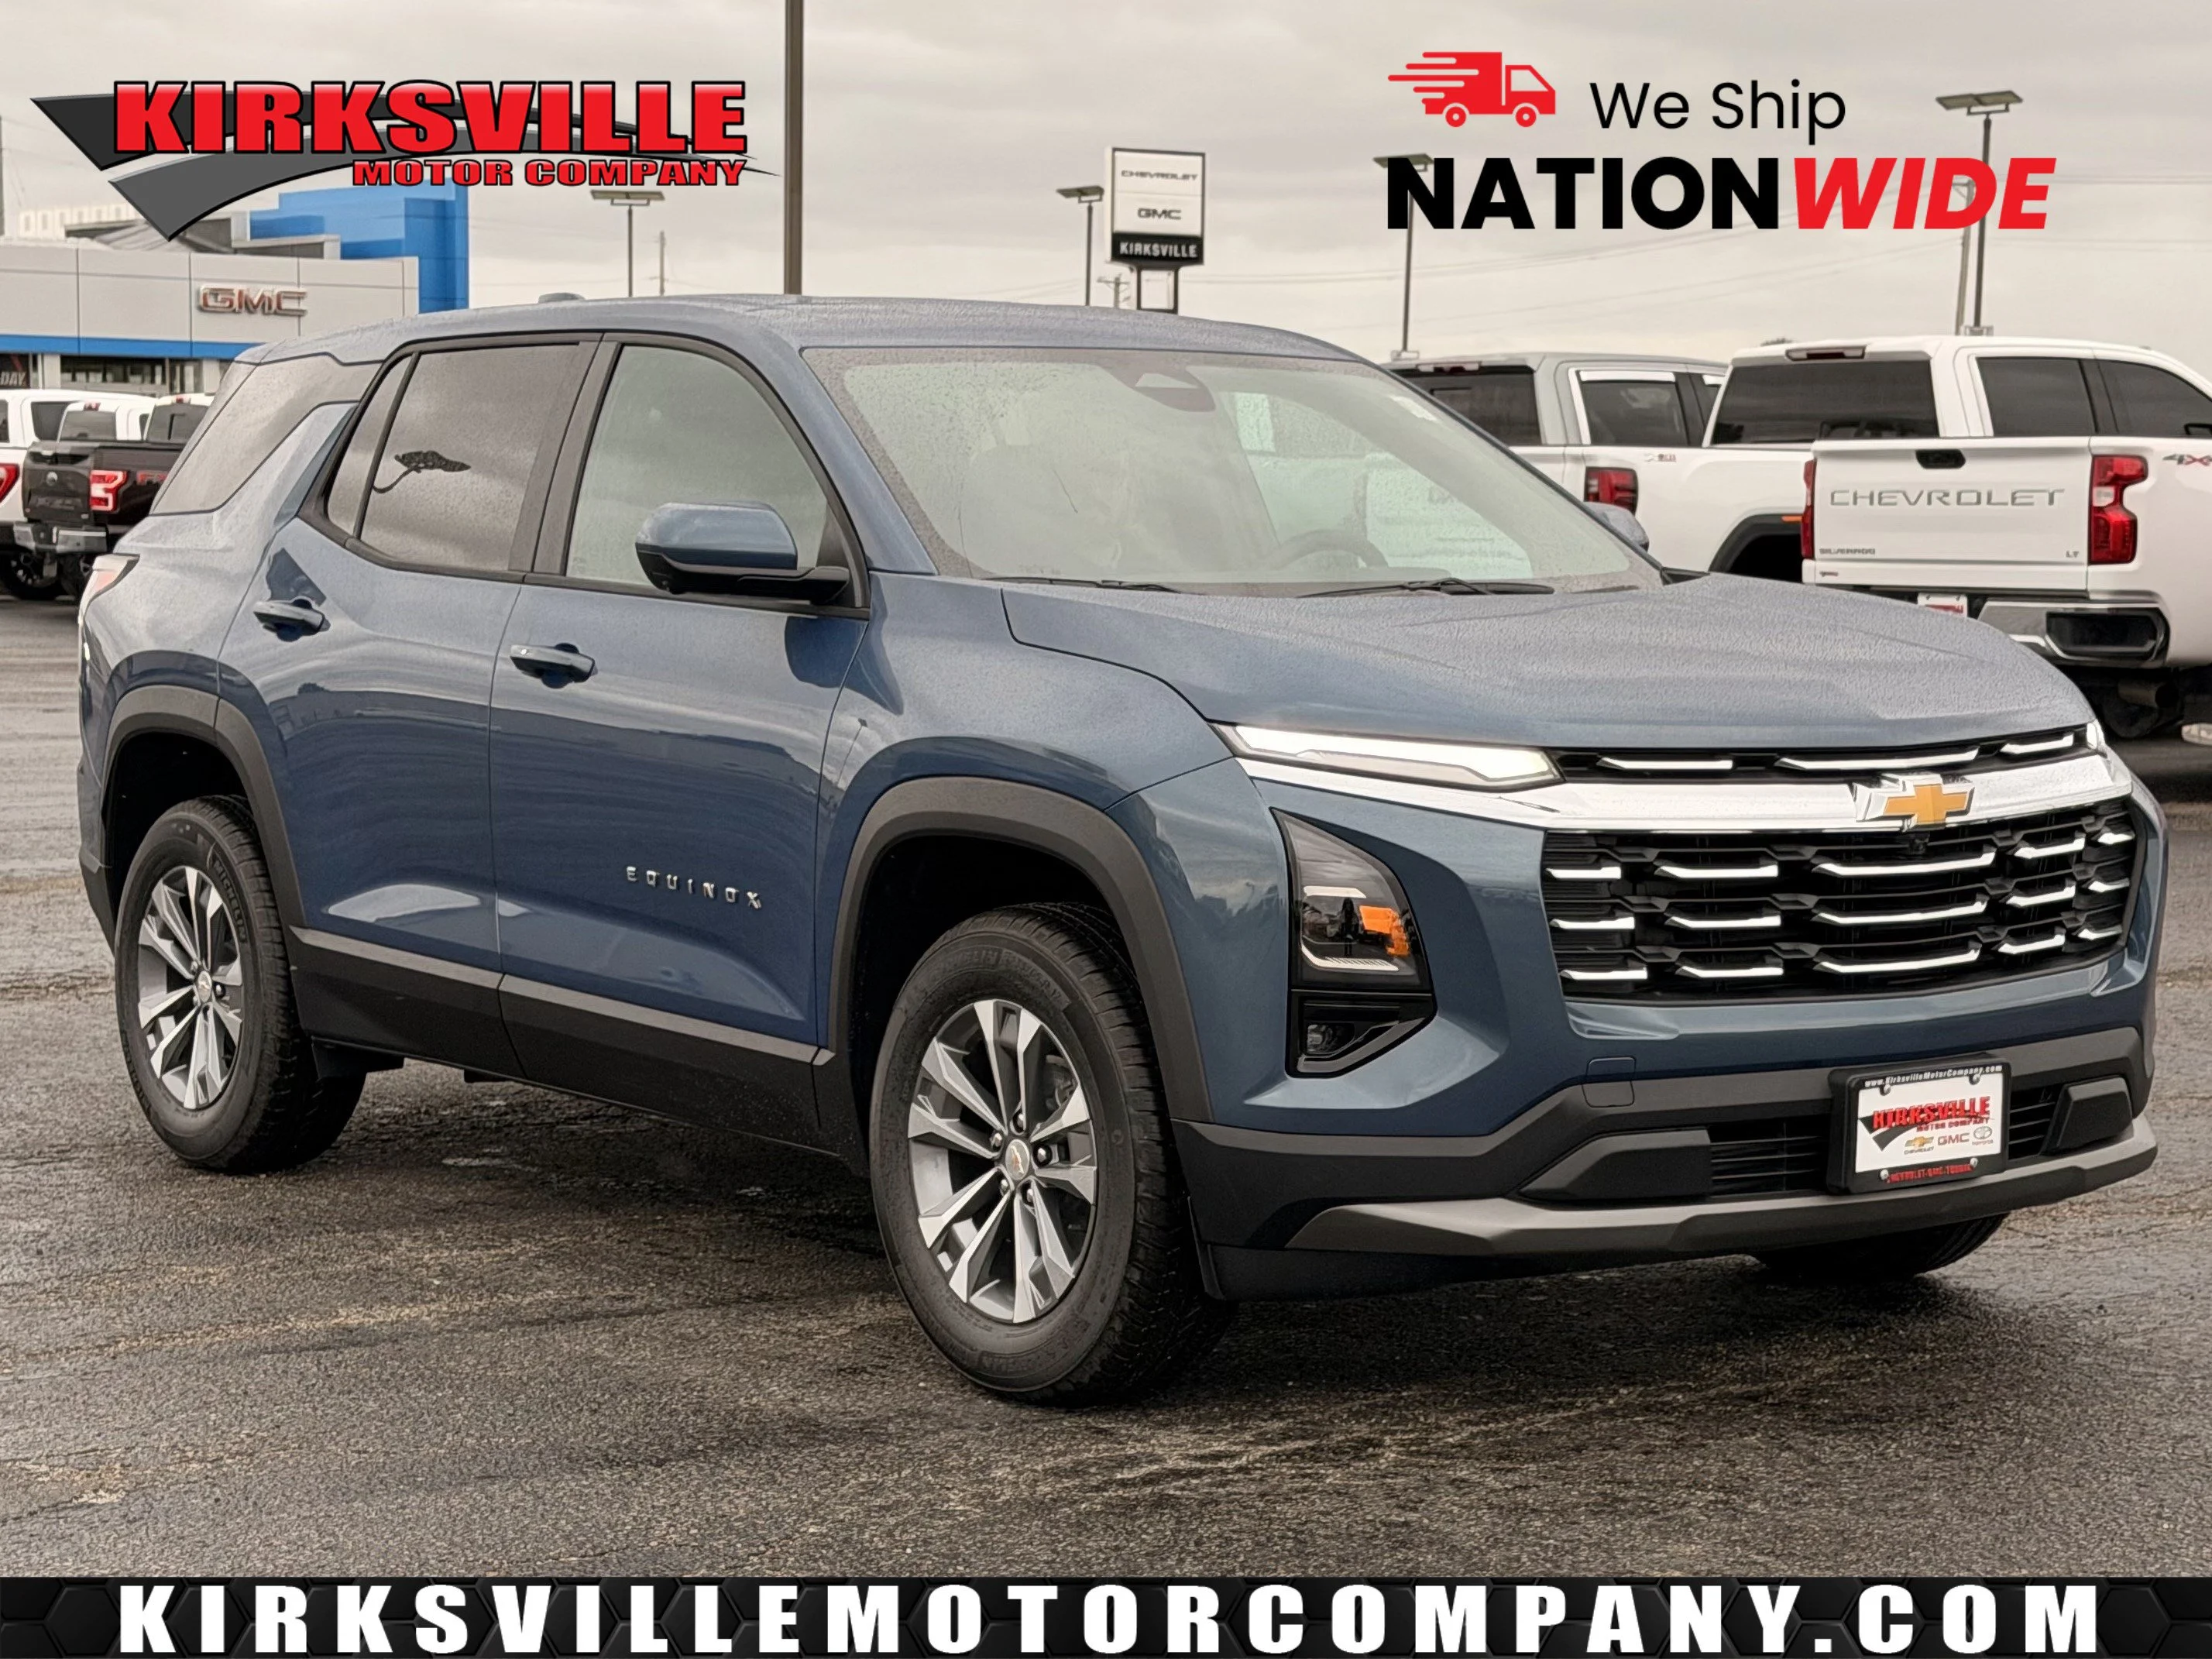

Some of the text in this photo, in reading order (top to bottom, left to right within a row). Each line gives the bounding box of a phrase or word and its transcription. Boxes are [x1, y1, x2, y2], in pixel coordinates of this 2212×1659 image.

[1121, 170, 1198, 181] CHEVROLET
[1137, 208, 1182, 220] GMC
[1119, 242, 1198, 258] KIRKSVILLE
[198, 284, 307, 316] GMC
[2162, 453, 2212, 466] 4X
[1830, 489, 2065, 507] CHEVROLET
[626, 865, 762, 909] EQUINOX
[1872, 1095, 1990, 1130] KIRKSVILLE
[1937, 1132, 1970, 1146] GMC
